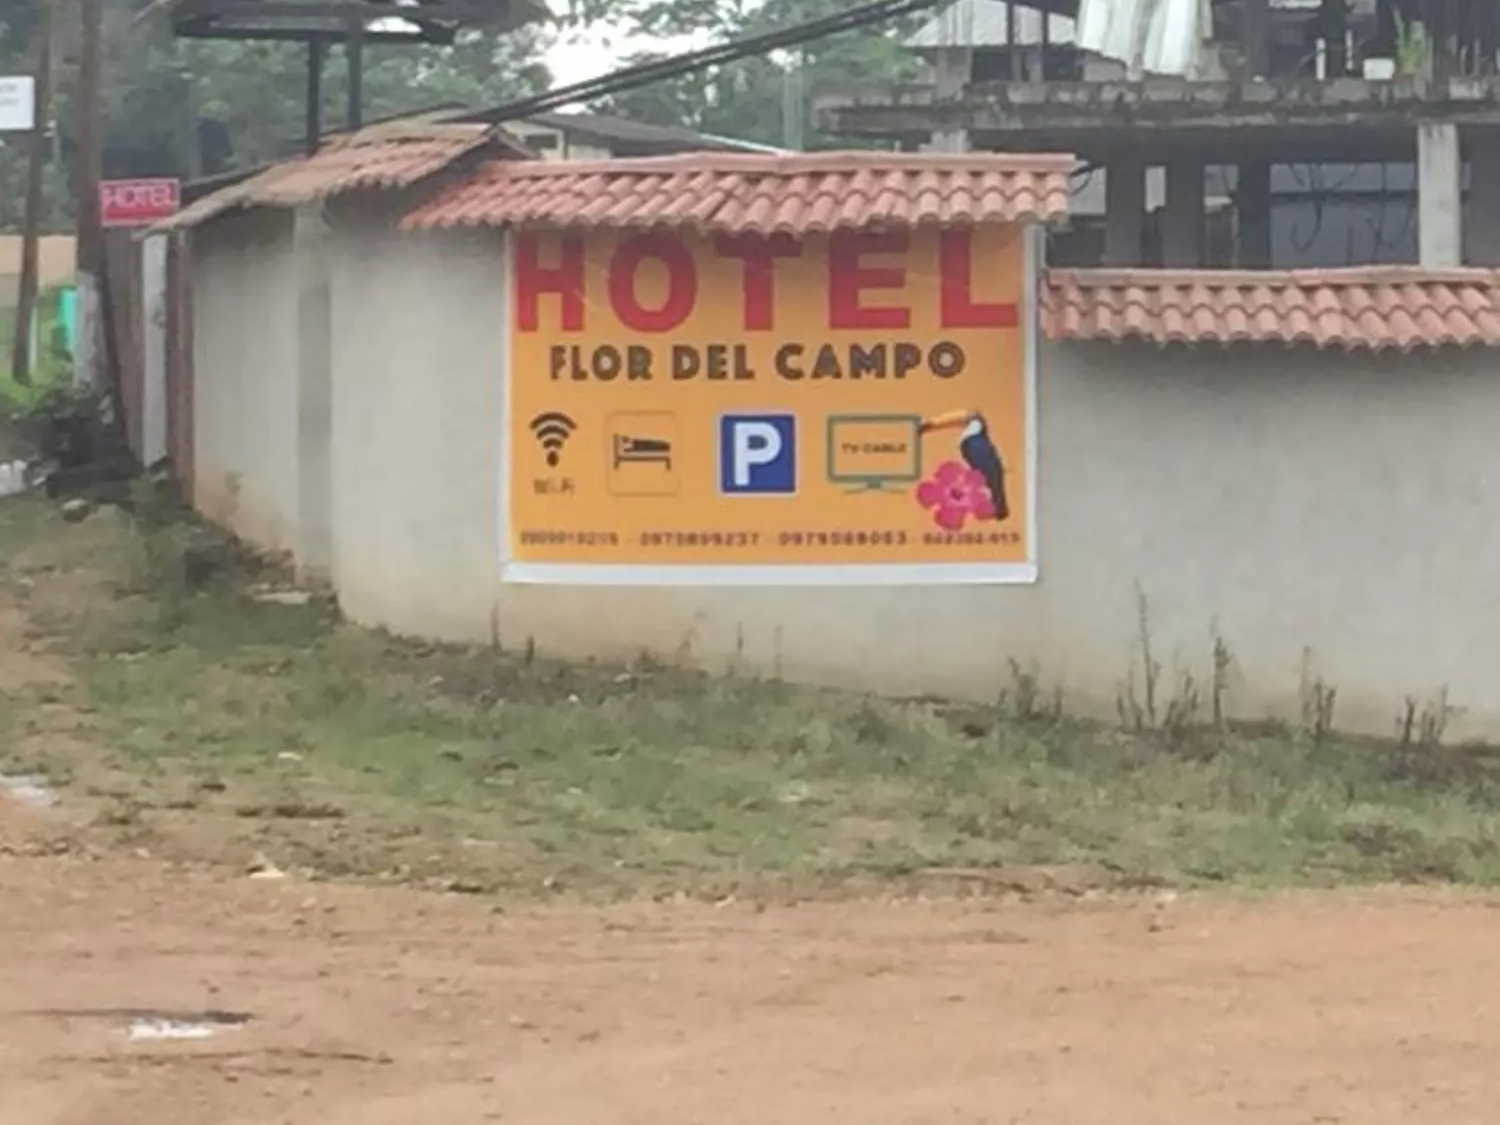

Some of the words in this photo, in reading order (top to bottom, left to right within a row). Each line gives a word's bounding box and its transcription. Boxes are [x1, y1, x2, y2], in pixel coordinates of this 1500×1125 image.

[102, 185, 174, 208] HOTEL
[516, 225, 1017, 333] HOTEL
[551, 344, 653, 380] FLOR
[672, 344, 755, 379] DEL
[774, 341, 966, 380] CAMPO
[732, 420, 783, 487] P
